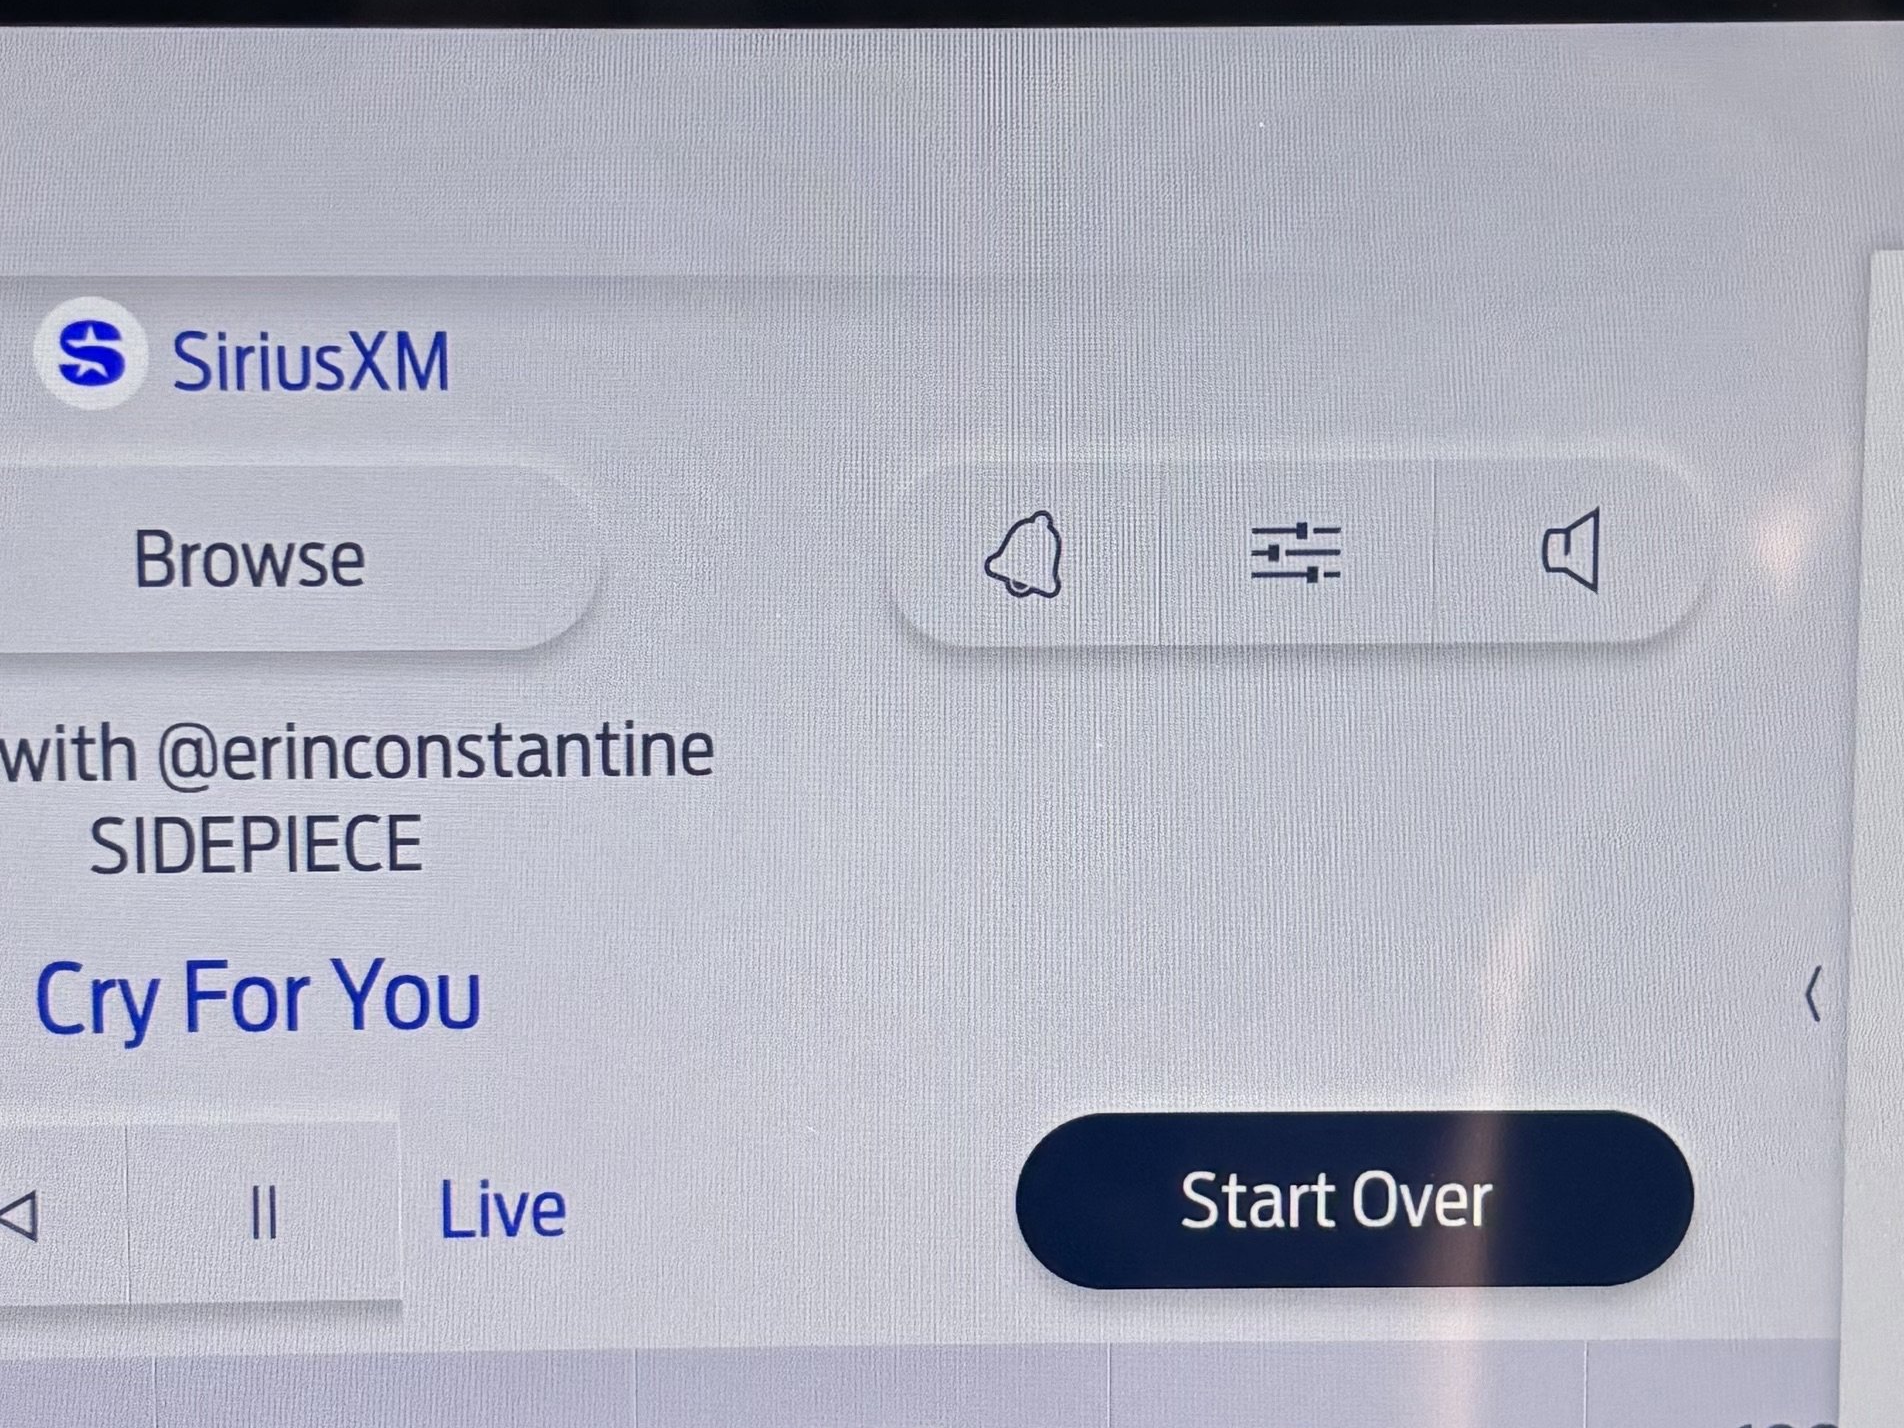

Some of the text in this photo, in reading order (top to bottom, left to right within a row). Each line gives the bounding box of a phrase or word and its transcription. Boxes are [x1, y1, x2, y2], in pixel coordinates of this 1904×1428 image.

[173, 329, 448, 392] SiriusXM
[135, 528, 365, 588] Browse
[158, 719, 714, 794] @erinconstantine
[90, 813, 422, 875] SIDEPIECE
[36, 957, 480, 1050] Cry For You
[441, 1179, 566, 1239] Live
[1182, 1170, 1494, 1229] Start Over
